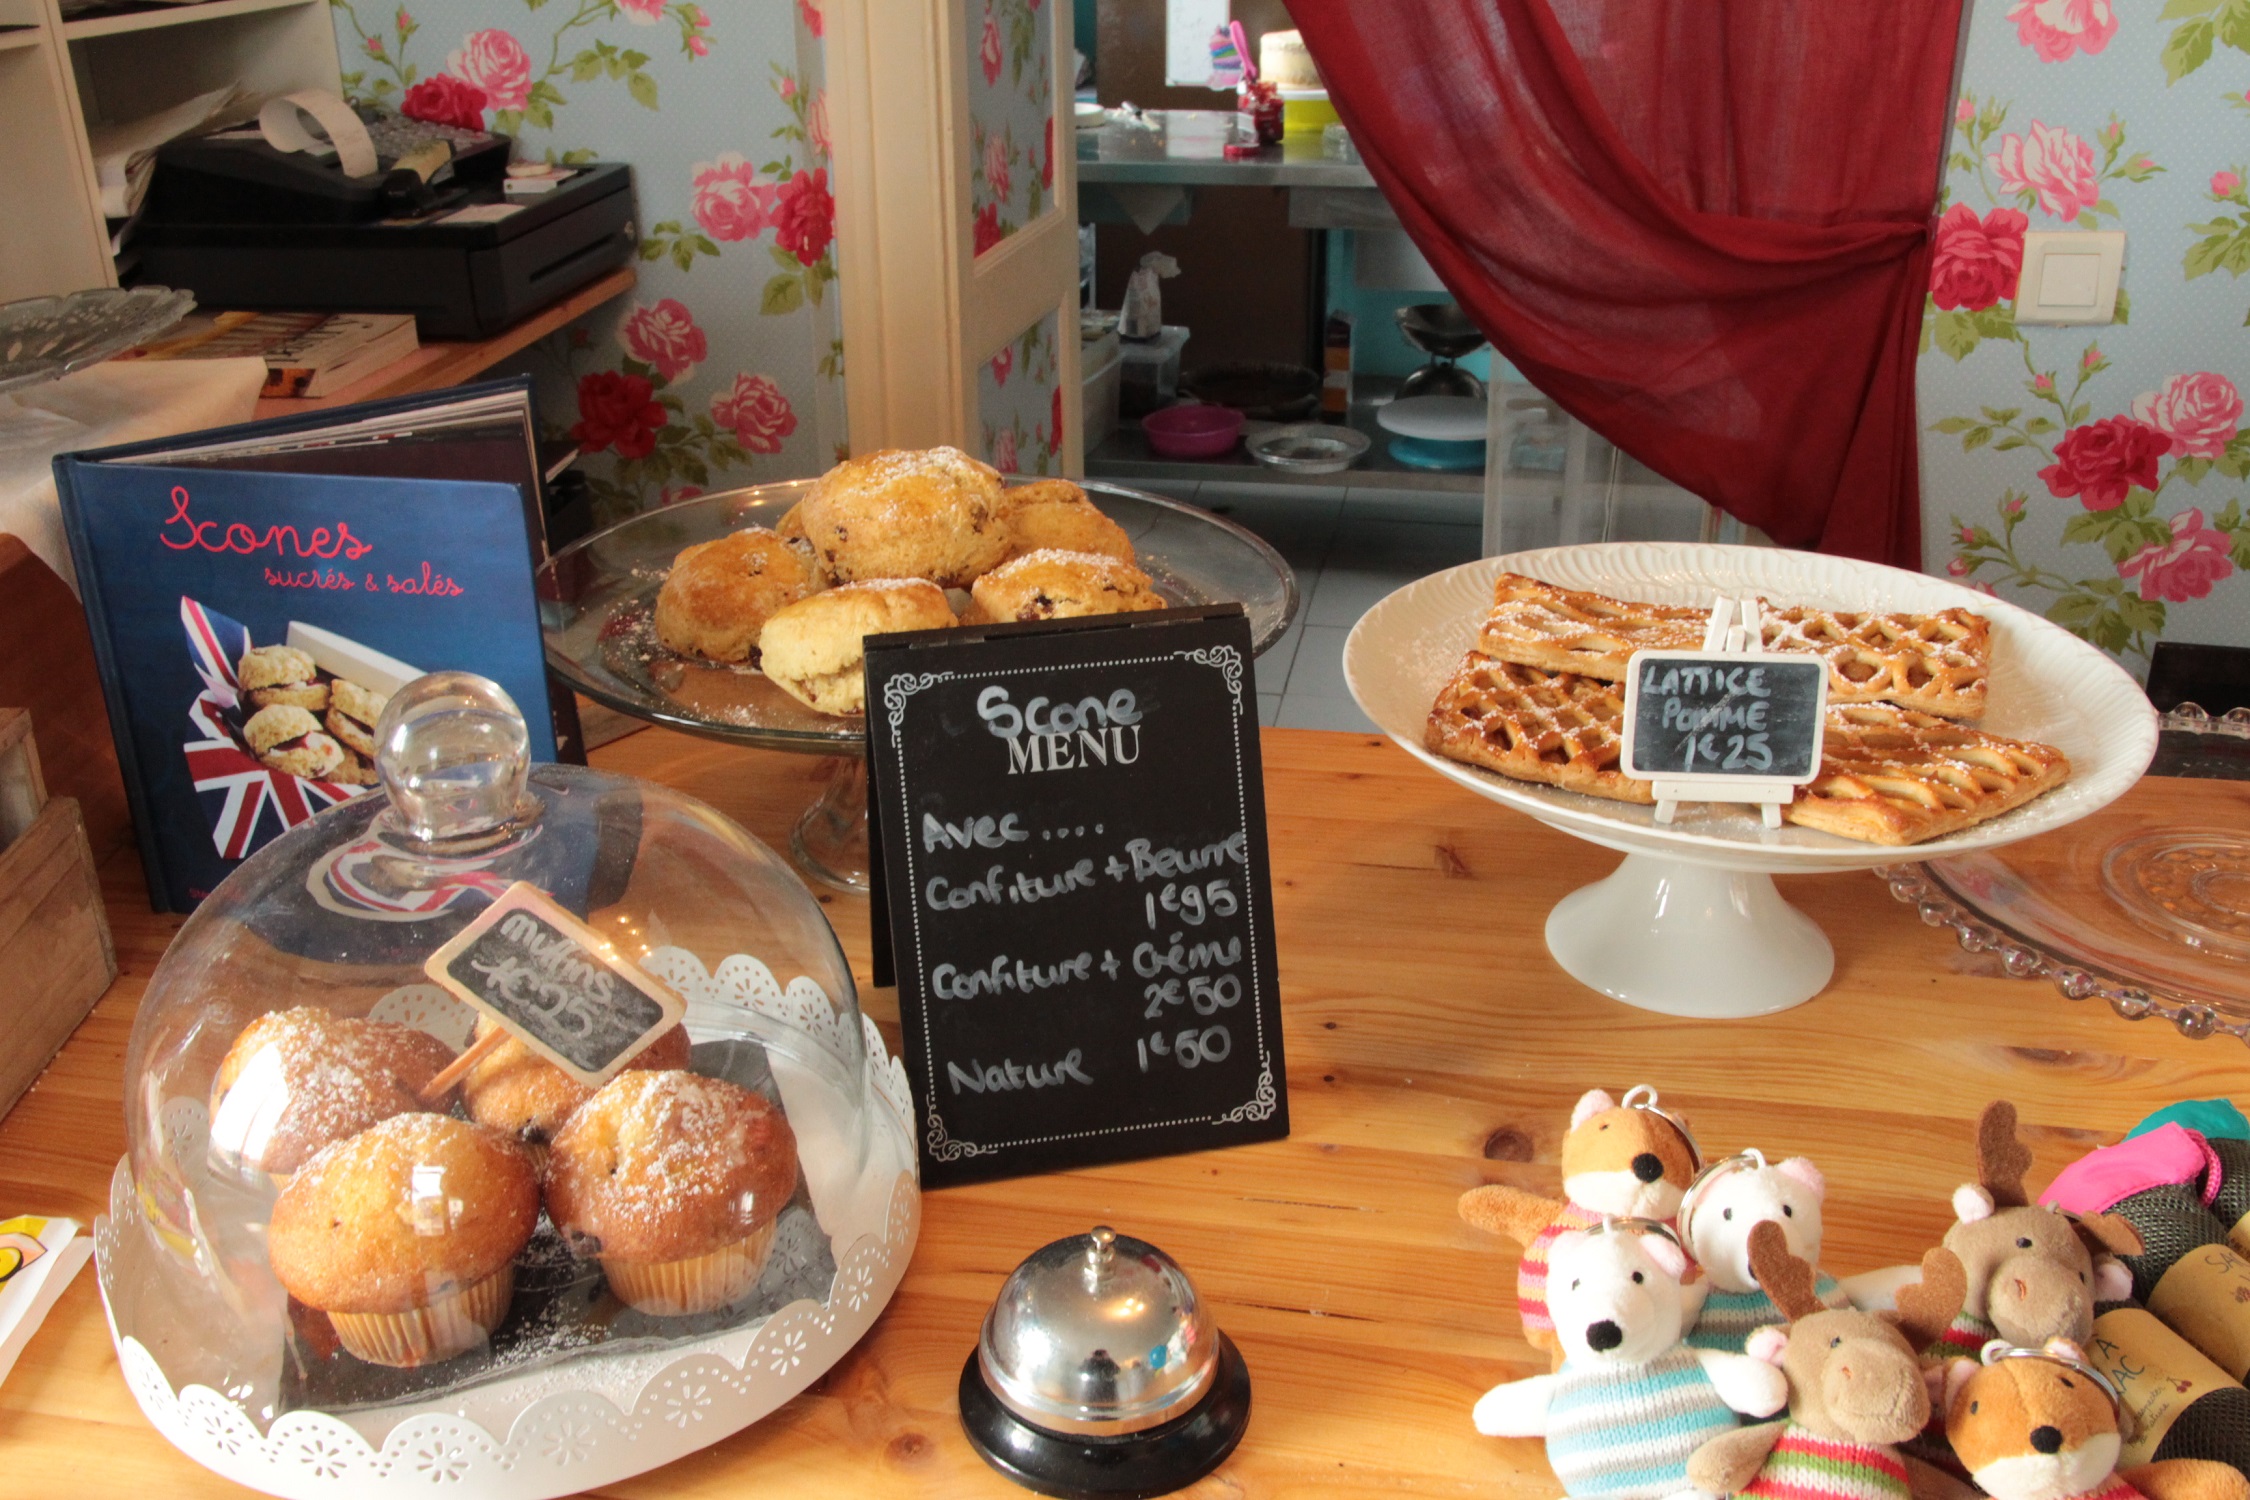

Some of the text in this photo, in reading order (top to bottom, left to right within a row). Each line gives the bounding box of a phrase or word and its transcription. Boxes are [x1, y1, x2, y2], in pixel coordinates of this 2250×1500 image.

[157, 486, 372, 560] Scones
[265, 561, 464, 597] sucrés & salés
[1641, 665, 1771, 697] LATTICE
[976, 685, 1143, 738] Scone
[1007, 725, 1141, 775] MENU
[925, 858, 1096, 911] Confiture
[932, 951, 1093, 1000] Confiture
[947, 1047, 1094, 1095] Nature
